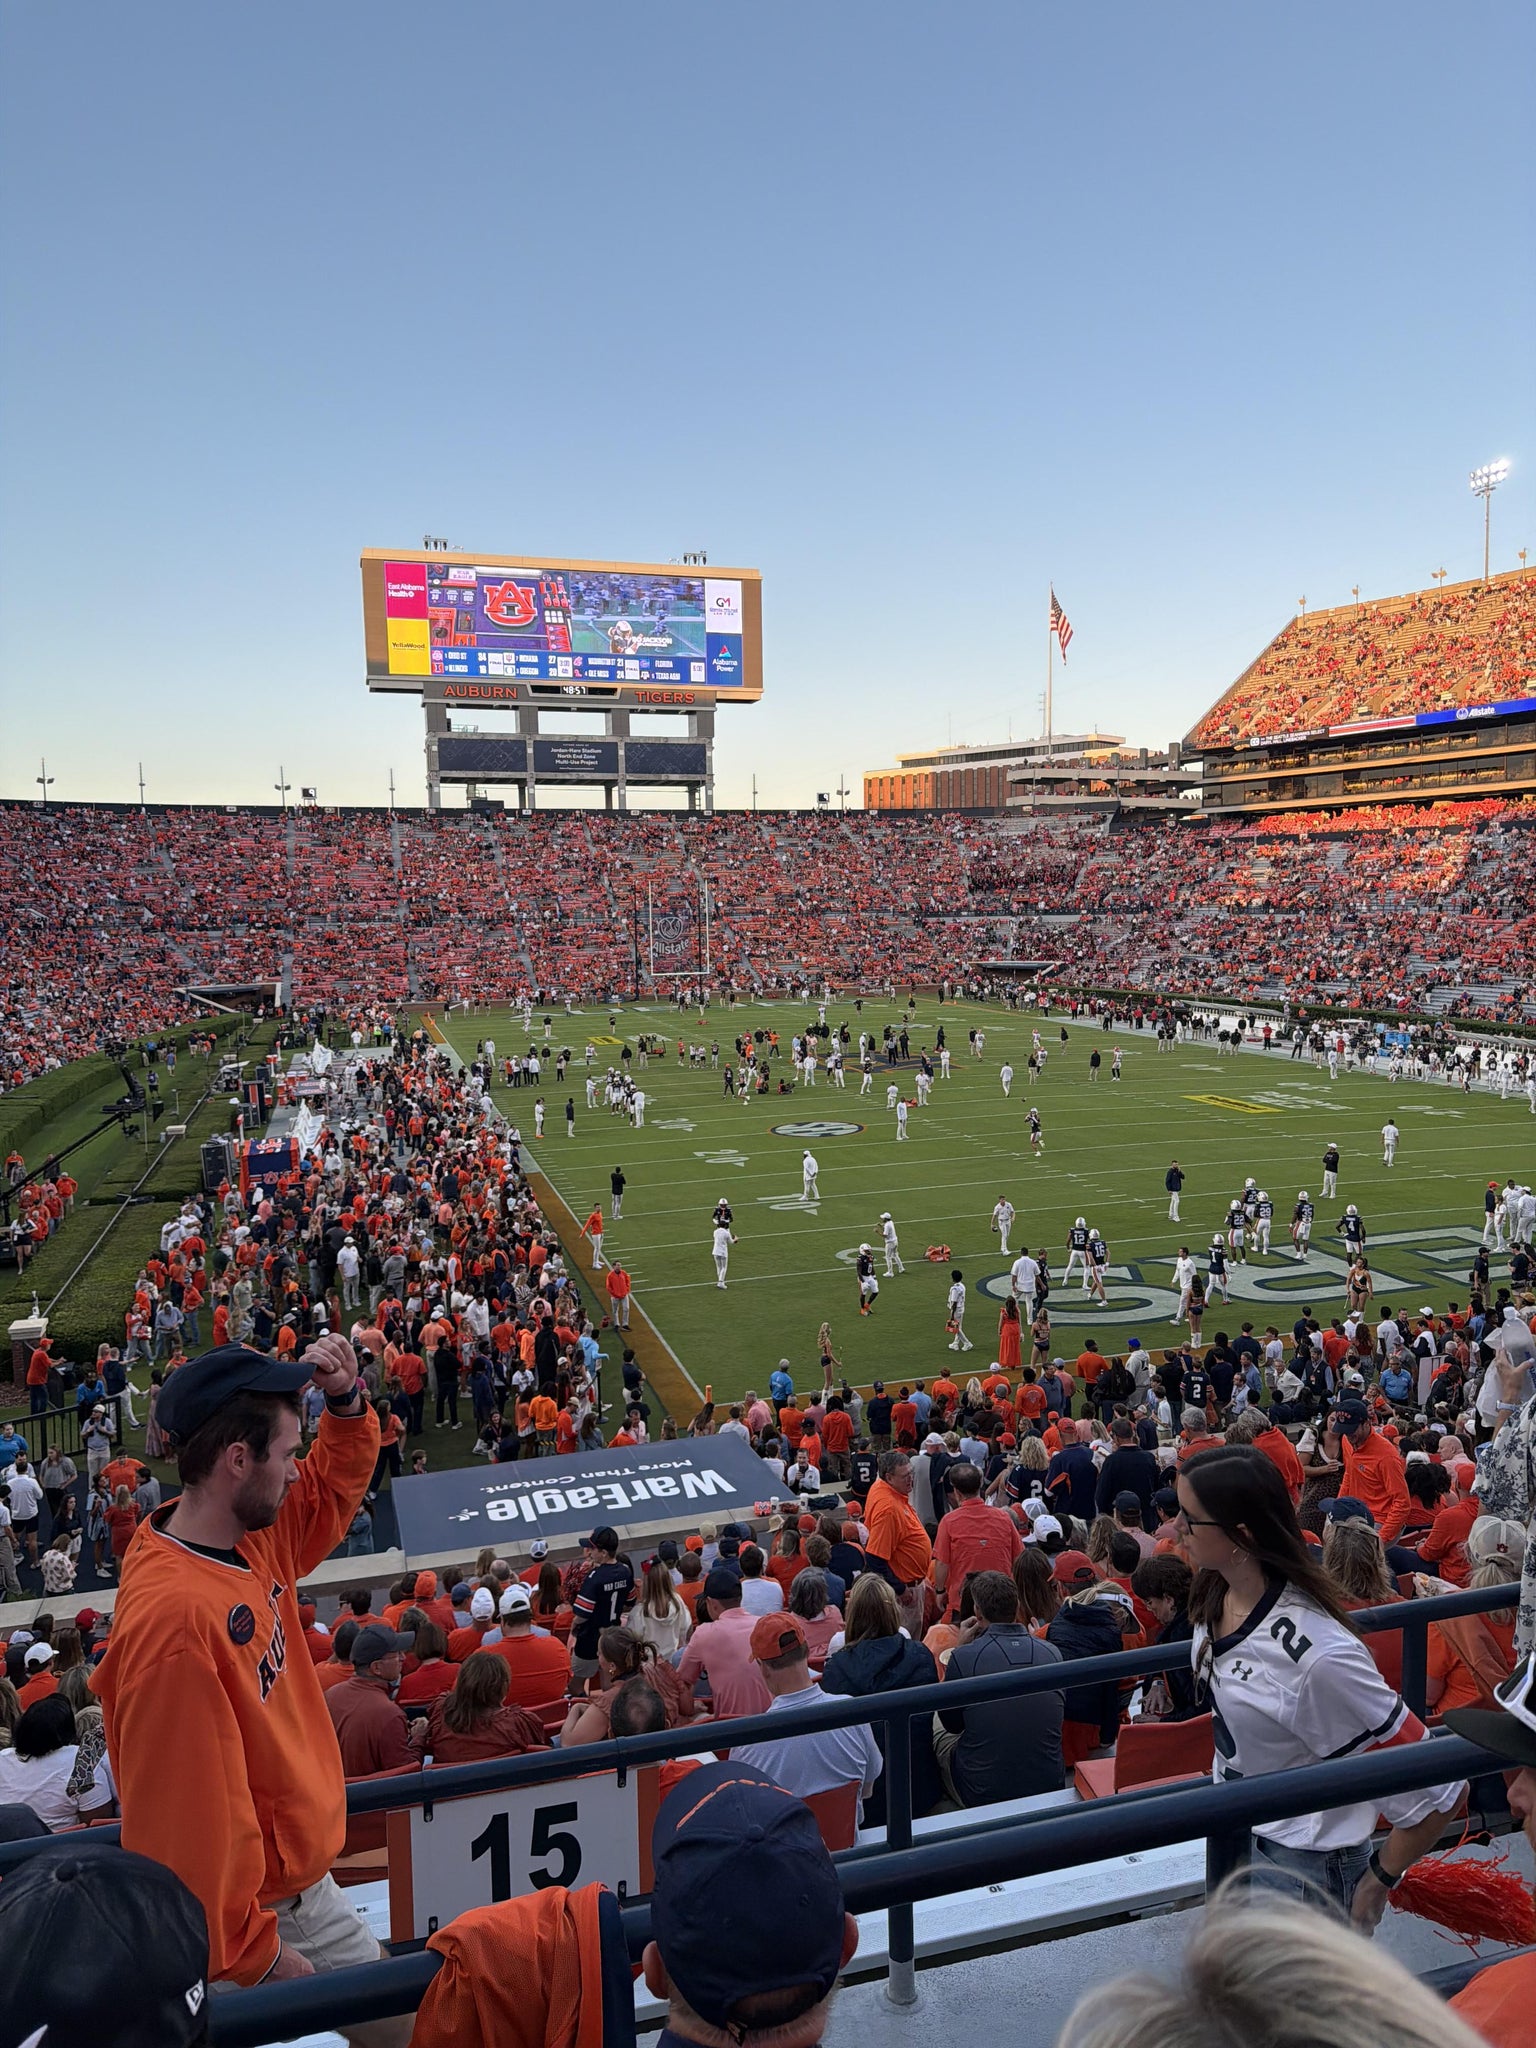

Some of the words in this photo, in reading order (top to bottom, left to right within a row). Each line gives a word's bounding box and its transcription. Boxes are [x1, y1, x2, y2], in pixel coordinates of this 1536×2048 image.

[387, 582, 400, 590] East
[400, 583, 425, 591] Alabama
[548, 655, 556, 664] 27
[617, 658, 624, 666] 21
[712, 658, 738, 666] Alabama
[444, 685, 517, 699] AUBURN
[563, 686, 586, 695] 48:57
[635, 691, 696, 704] TIGERS
[1468, 706, 1496, 717] Allstate
[652, 939, 689, 955] Allstate
[693, 1148, 750, 1166] 20
[1260, 1207, 1272, 1217] 29
[1302, 1208, 1312, 1218] 35
[1234, 1215, 1244, 1225] 22
[1348, 1220, 1355, 1232] 4
[1074, 1234, 1086, 1245] 12
[1094, 1245, 1105, 1258] 16
[1211, 1251, 1217, 1263] 1
[1192, 1383, 1201, 1399] 2
[638, 1459, 693, 1470] More
[581, 1466, 636, 1480] Than
[860, 1468, 870, 1483] 2
[480, 1475, 576, 1494] Content.
[1030, 1480, 1043, 1499] 2
[485, 1469, 738, 1523] WarEagle
[604, 1582, 614, 1592] WAR
[614, 1580, 628, 1590] EAGLE
[610, 1591, 618, 1622] 1
[1270, 1616, 1313, 1664] 2
[470, 1801, 582, 1903] 15
